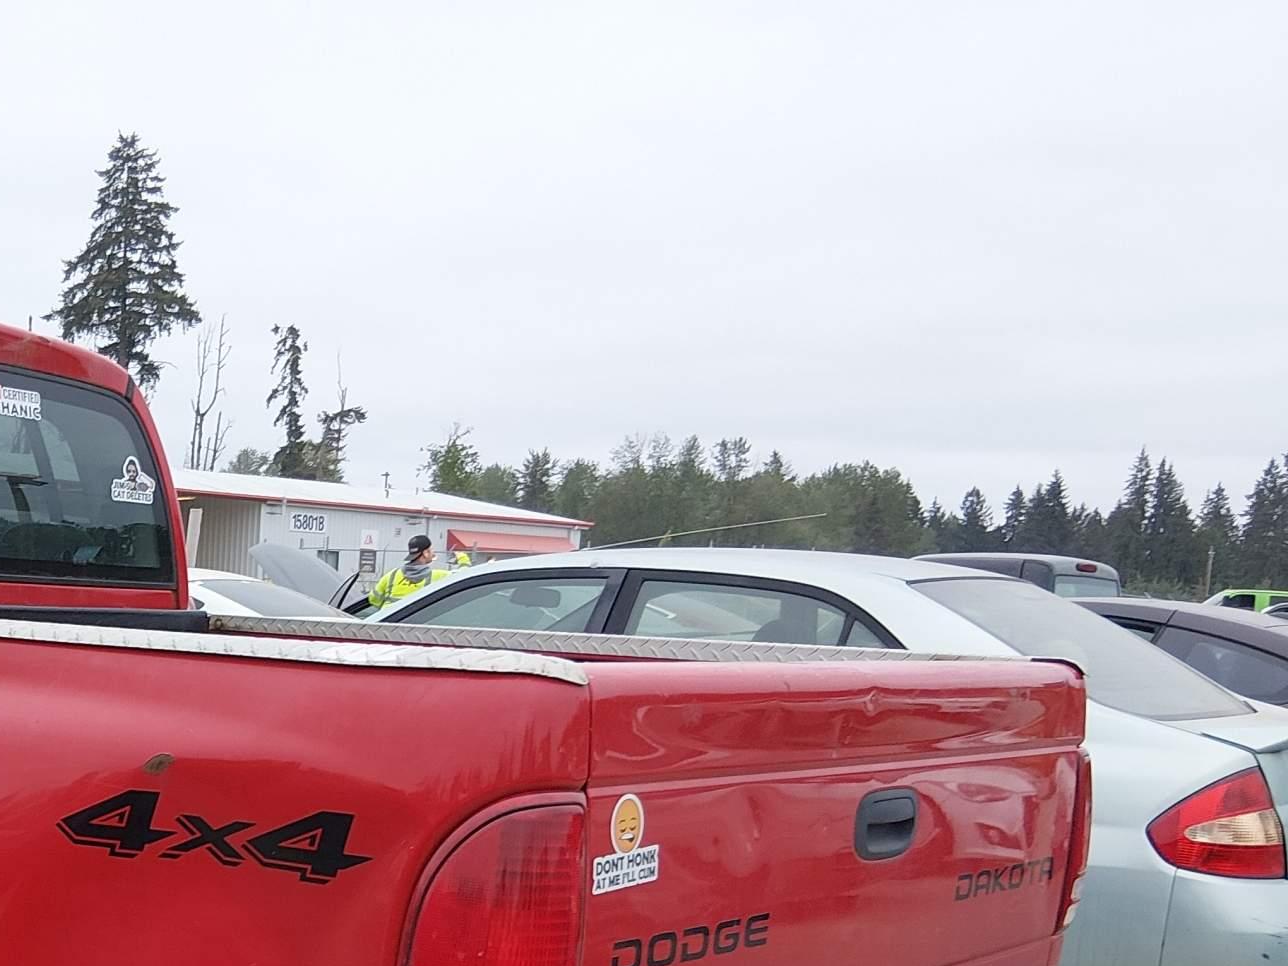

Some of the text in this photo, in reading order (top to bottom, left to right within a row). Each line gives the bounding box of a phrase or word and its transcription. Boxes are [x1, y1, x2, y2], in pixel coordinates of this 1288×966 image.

[2, 388, 40, 404] CERTIFIED
[292, 513, 325, 532] 15801B
[596, 849, 657, 877] DONT HONK
[595, 878, 607, 891] AT
[608, 874, 621, 888] ME
[638, 866, 656, 880] CUM
[954, 856, 1054, 901] DAKOTA
